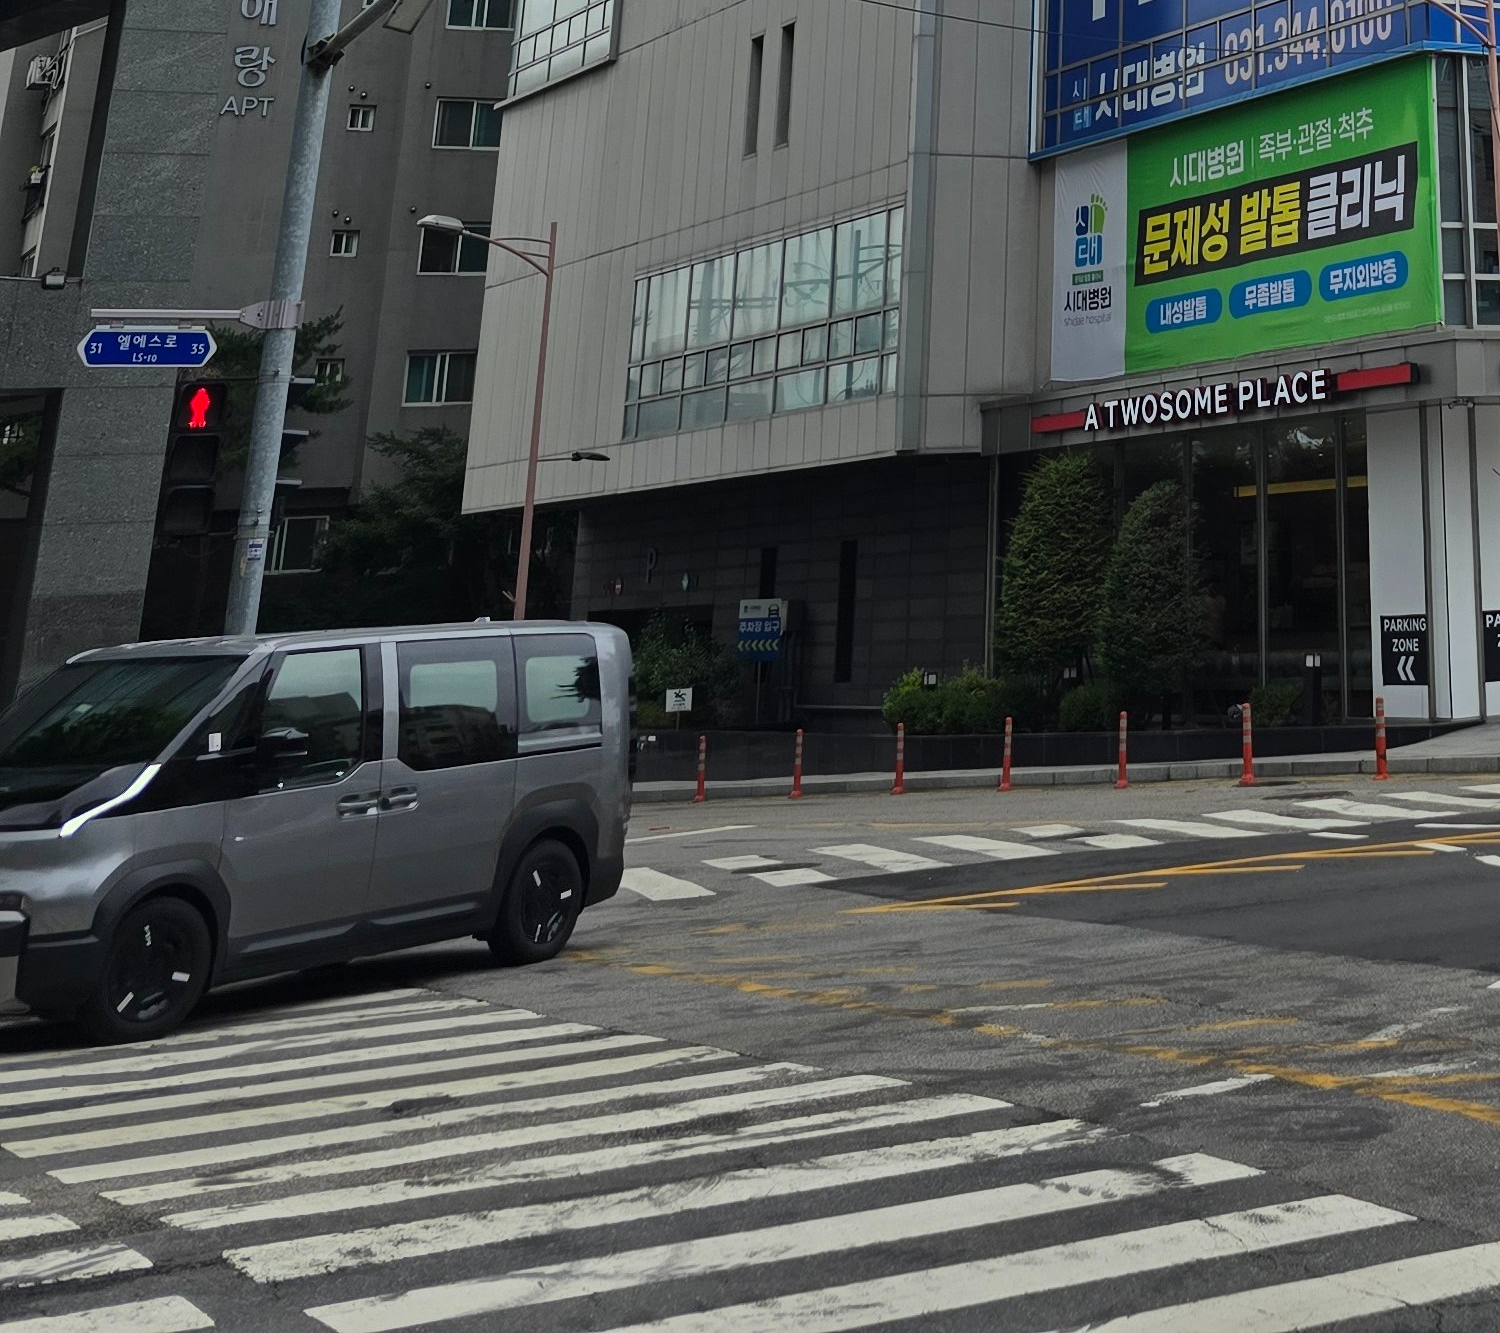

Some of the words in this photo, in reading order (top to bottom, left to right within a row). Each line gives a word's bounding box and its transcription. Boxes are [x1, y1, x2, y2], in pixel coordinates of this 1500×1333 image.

[1095, 41, 1205, 122] 시대병원
[220, 96, 275, 117] APT
[1168, 139, 1245, 188] 시대병원
[1143, 198, 1231, 276] 문제성
[1239, 180, 1301, 256] 발톱
[1306, 154, 1406, 241] 클리닉
[1329, 258, 1397, 295] 무지외반증
[1063, 285, 1112, 313] 시대병원
[1244, 278, 1295, 310] 무좀발톱
[1085, 311, 1112, 326] hospital
[1159, 295, 1208, 326] 내성발톱
[89, 342, 103, 354] 31
[117, 334, 178, 351] 엘에스로
[190, 343, 205, 355] 35
[132, 353, 157, 363] LS-ro
[1084, 403, 1099, 431] A
[1104, 383, 1229, 428] TWOSOME
[1237, 369, 1327, 411] PLACE
[646, 547, 657, 584] P
[738, 620, 762, 633] 주차장
[764, 620, 780, 632] 입구
[1383, 617, 1427, 632] PARKING
[1392, 637, 1420, 652] ZONE
